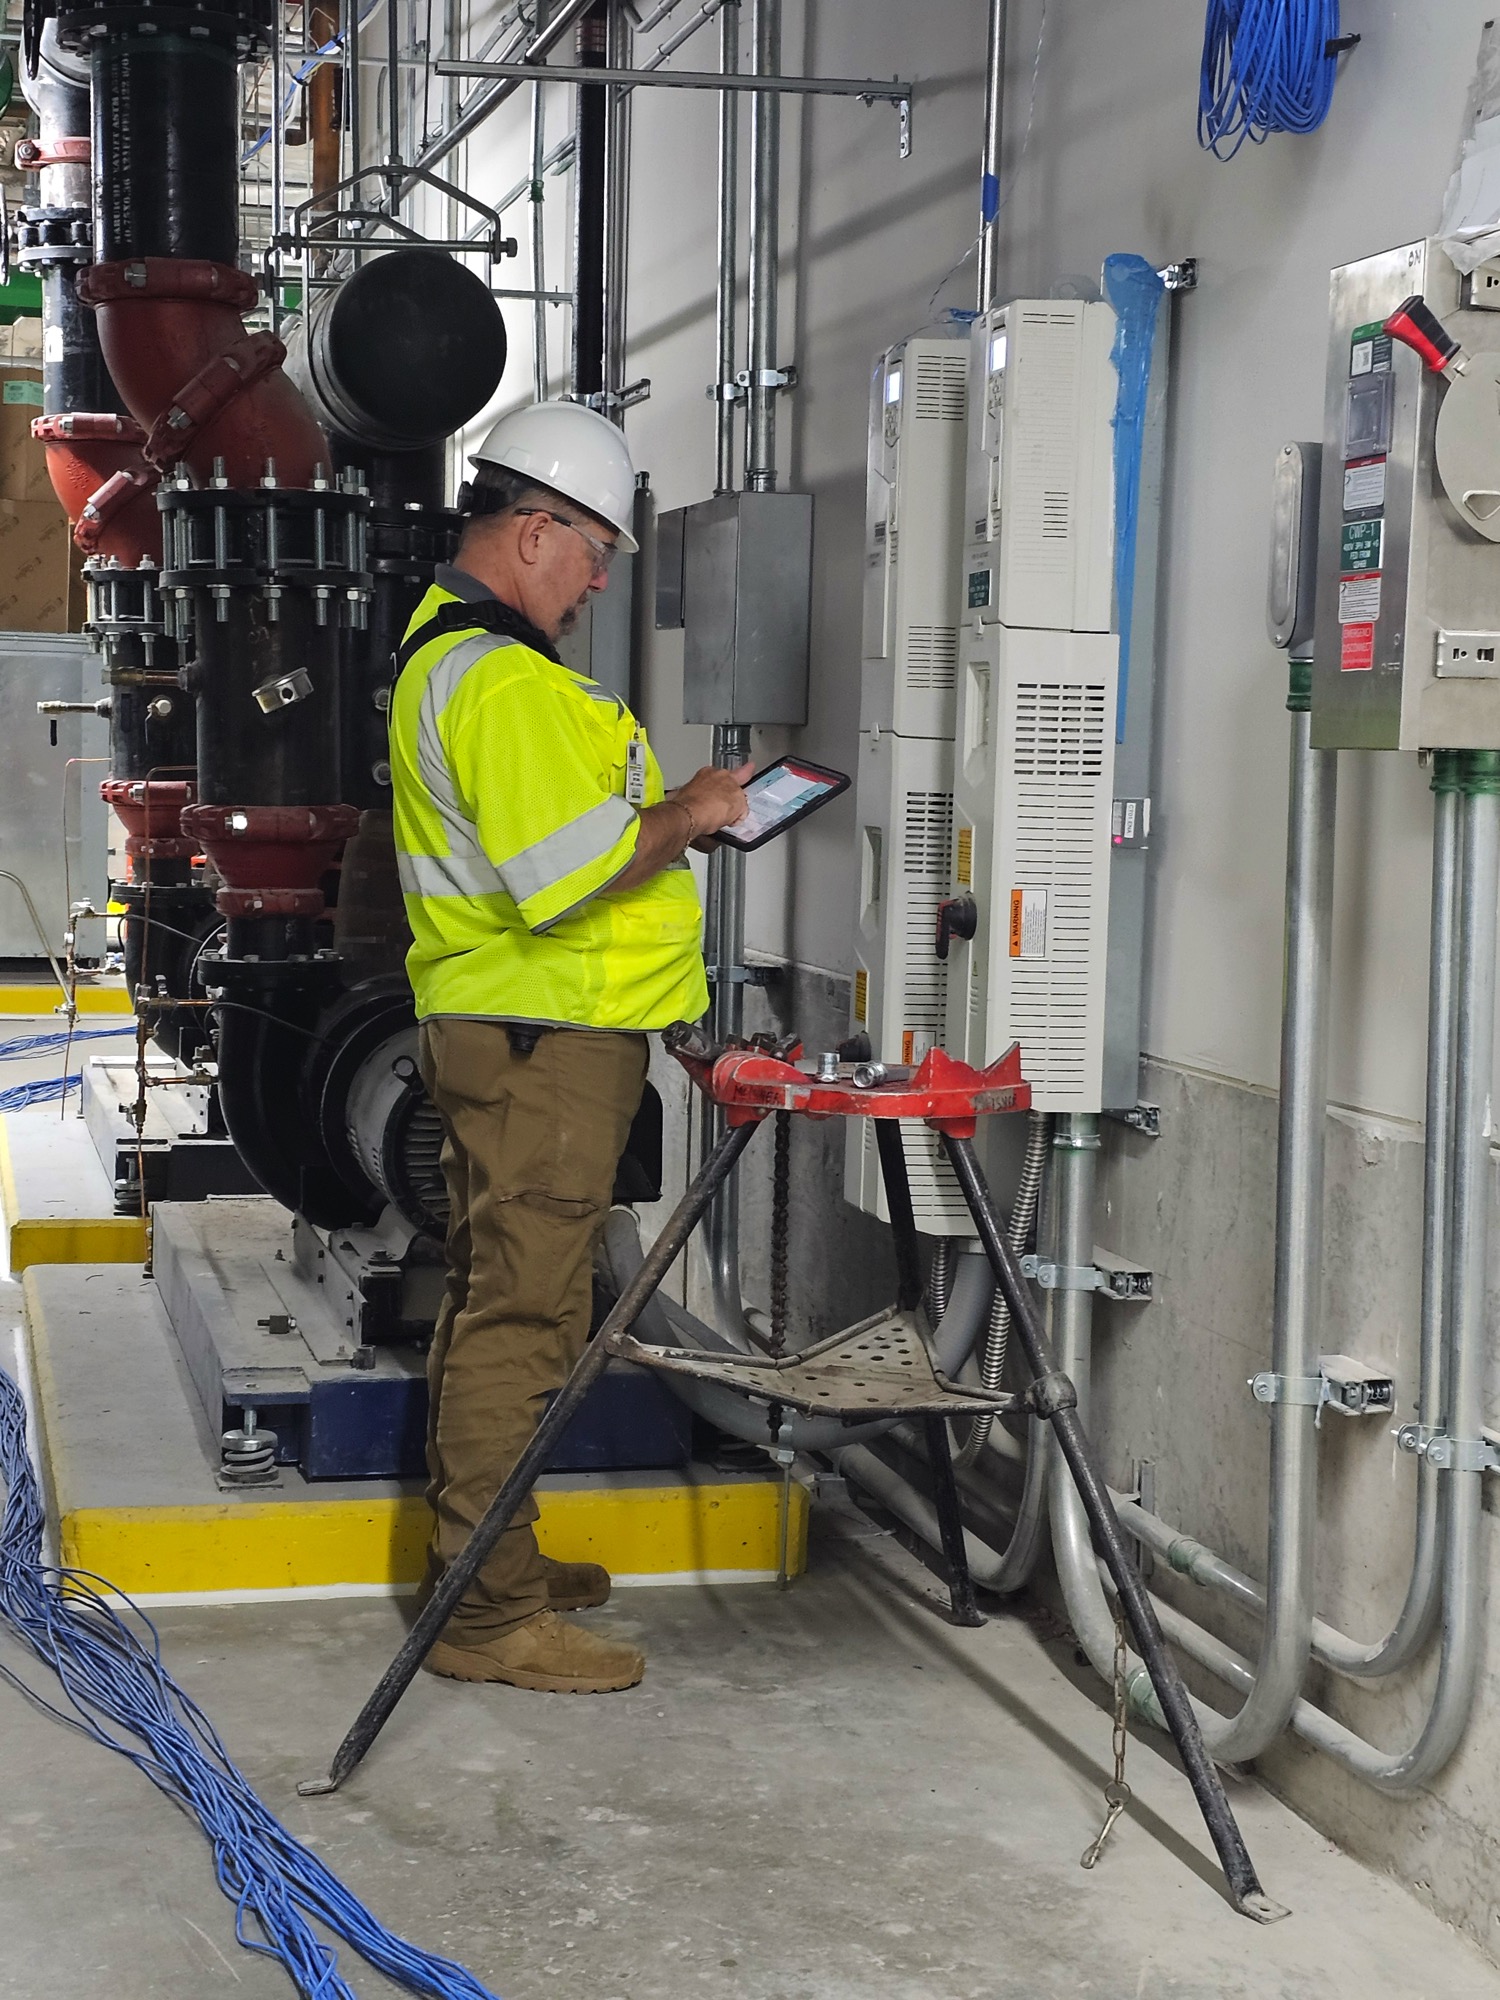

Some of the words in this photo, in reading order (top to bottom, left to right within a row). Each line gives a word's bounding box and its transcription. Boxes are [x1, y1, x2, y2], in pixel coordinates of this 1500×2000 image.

[111, 95, 120, 128] ASTM
[1408, 249, 1421, 267] ON
[1349, 523, 1375, 540] CWP-1
[1381, 661, 1400, 675] OFF
[1011, 899, 1020, 937] WARNING
